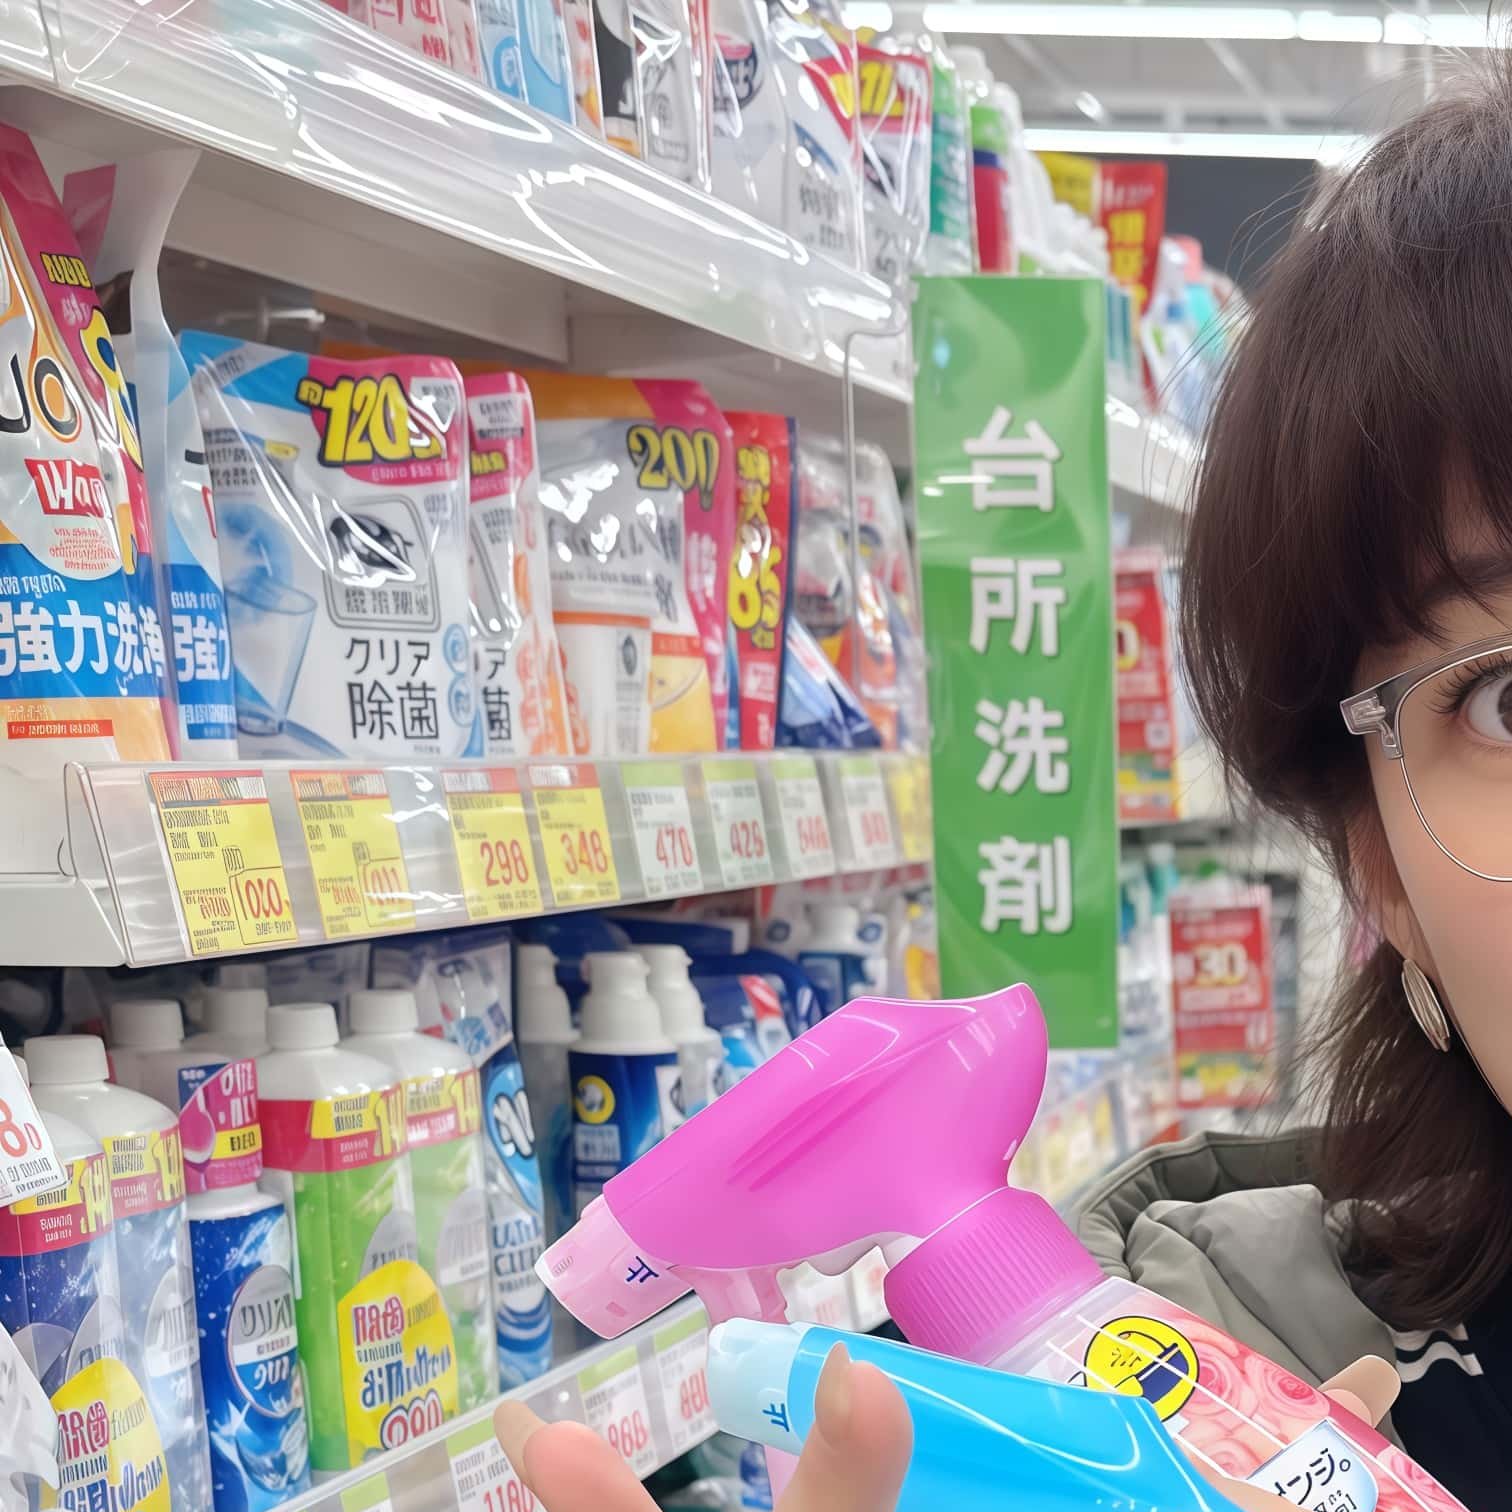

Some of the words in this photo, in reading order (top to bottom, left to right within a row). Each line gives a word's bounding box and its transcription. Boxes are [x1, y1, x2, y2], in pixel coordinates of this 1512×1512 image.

[345, 637, 432, 676] クリア
[964, 404, 1075, 936] 台所洗剤
[350, 681, 440, 740] 除菌
